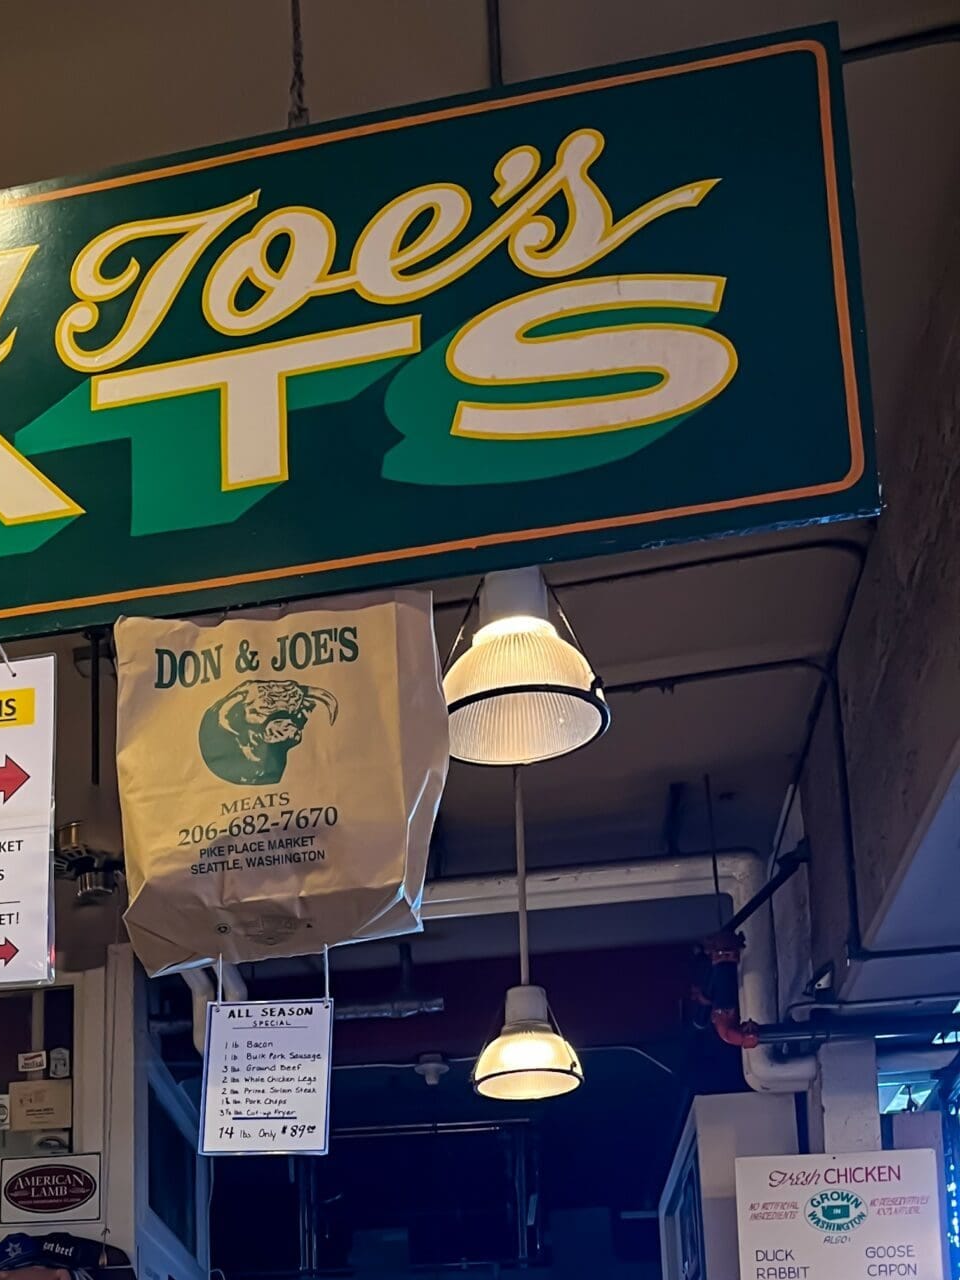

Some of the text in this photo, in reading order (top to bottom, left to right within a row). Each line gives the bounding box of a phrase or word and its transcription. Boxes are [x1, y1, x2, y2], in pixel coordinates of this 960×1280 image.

[55, 127, 722, 373] Joe's
[154, 626, 359, 689] DON & JOE'S
[220, 791, 290, 817] MEATS
[177, 806, 338, 847] 206-682-7670
[199, 836, 315, 859] PIKE PLACE MARKET
[190, 850, 326, 875] SEATTLE, WASHINGTON
[227, 1007, 313, 1019] ALL SEASON
[14, 1173, 85, 1190] AMERICAN
[823, 1165, 901, 1184] CHICKEN
[31, 1186, 67, 1197] LAMB
[810, 1191, 862, 1209] GROWN
[808, 1210, 866, 1231] WASHINGTON
[755, 1245, 915, 1262] DUCK GOOSE
[756, 1263, 917, 1280] RABBIT CAPON
